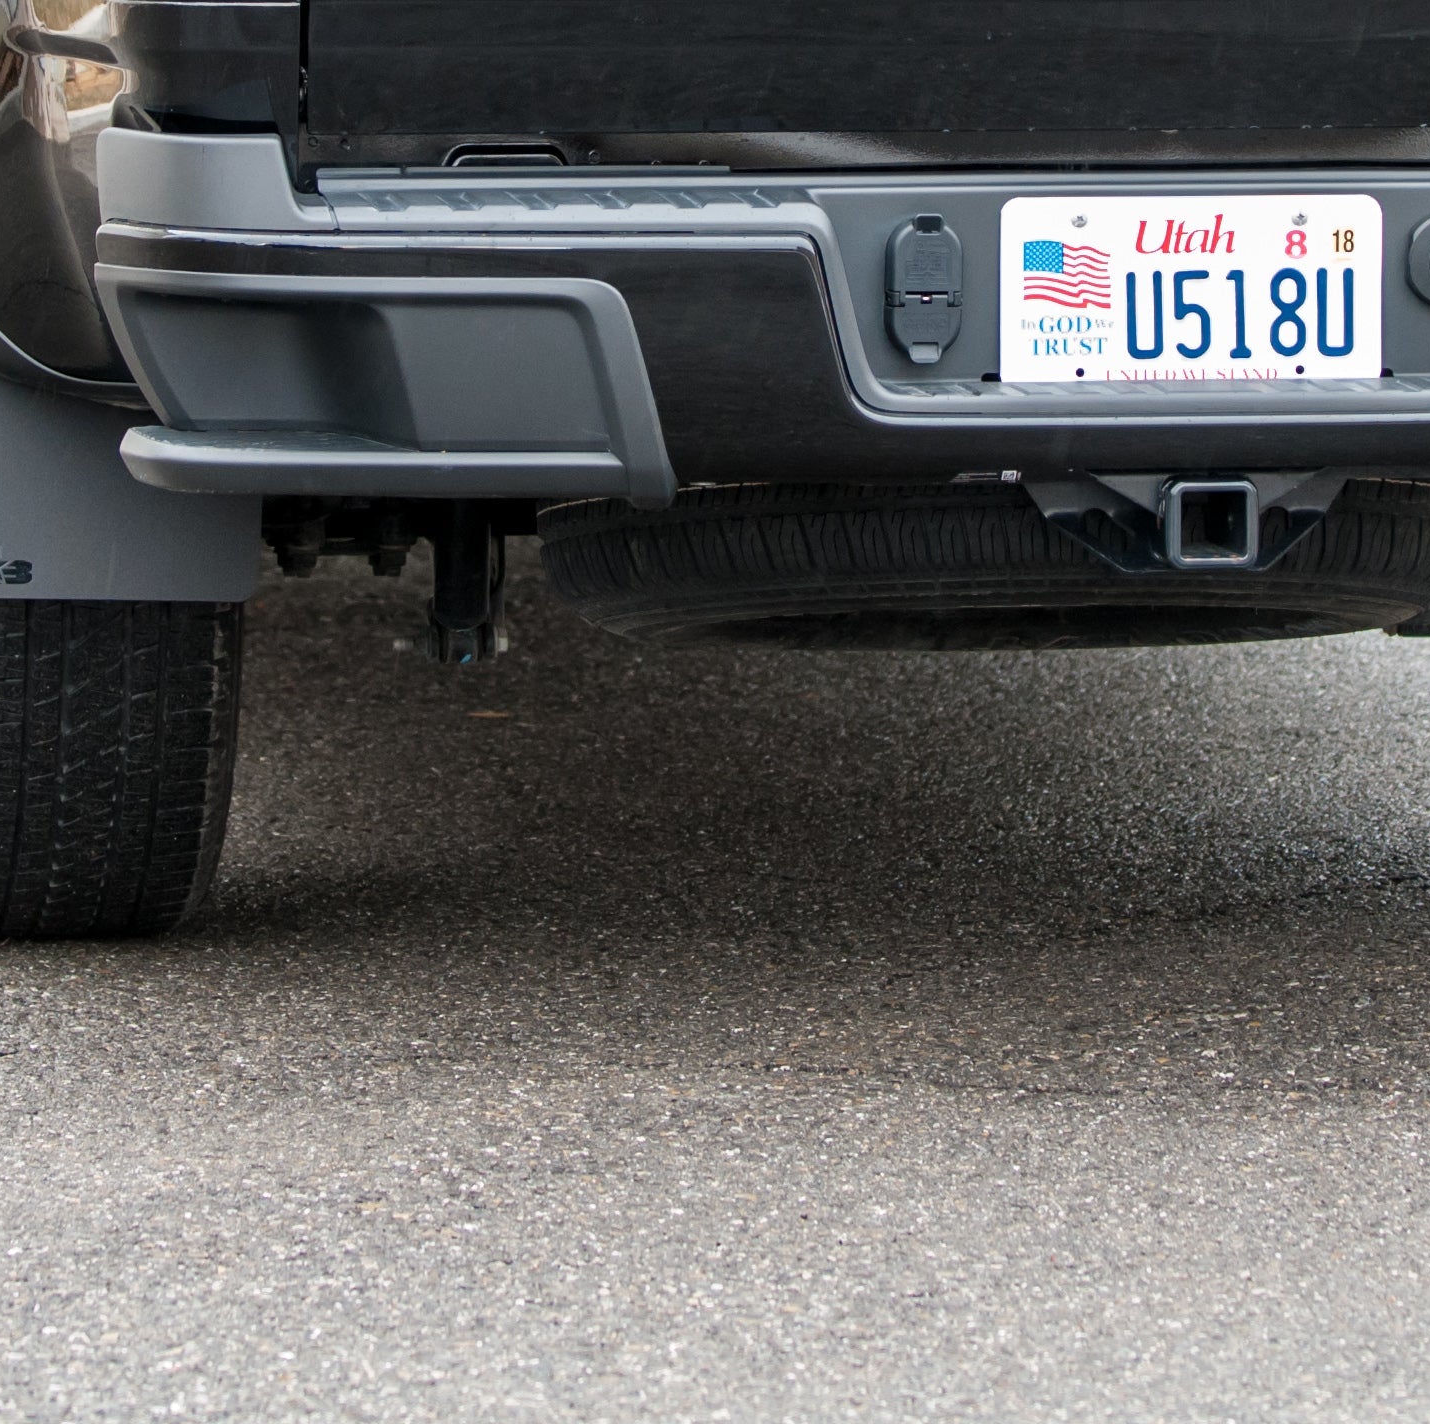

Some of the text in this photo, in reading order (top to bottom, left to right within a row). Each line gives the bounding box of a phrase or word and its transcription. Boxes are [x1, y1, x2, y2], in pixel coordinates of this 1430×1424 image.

[1135, 214, 1236, 255] Utah
[1284, 229, 1308, 260] 8
[1332, 228, 1355, 253] 18
[1038, 315, 1092, 334] GOD
[1126, 267, 1354, 360] U518U
[1028, 337, 1108, 356] TRUST
